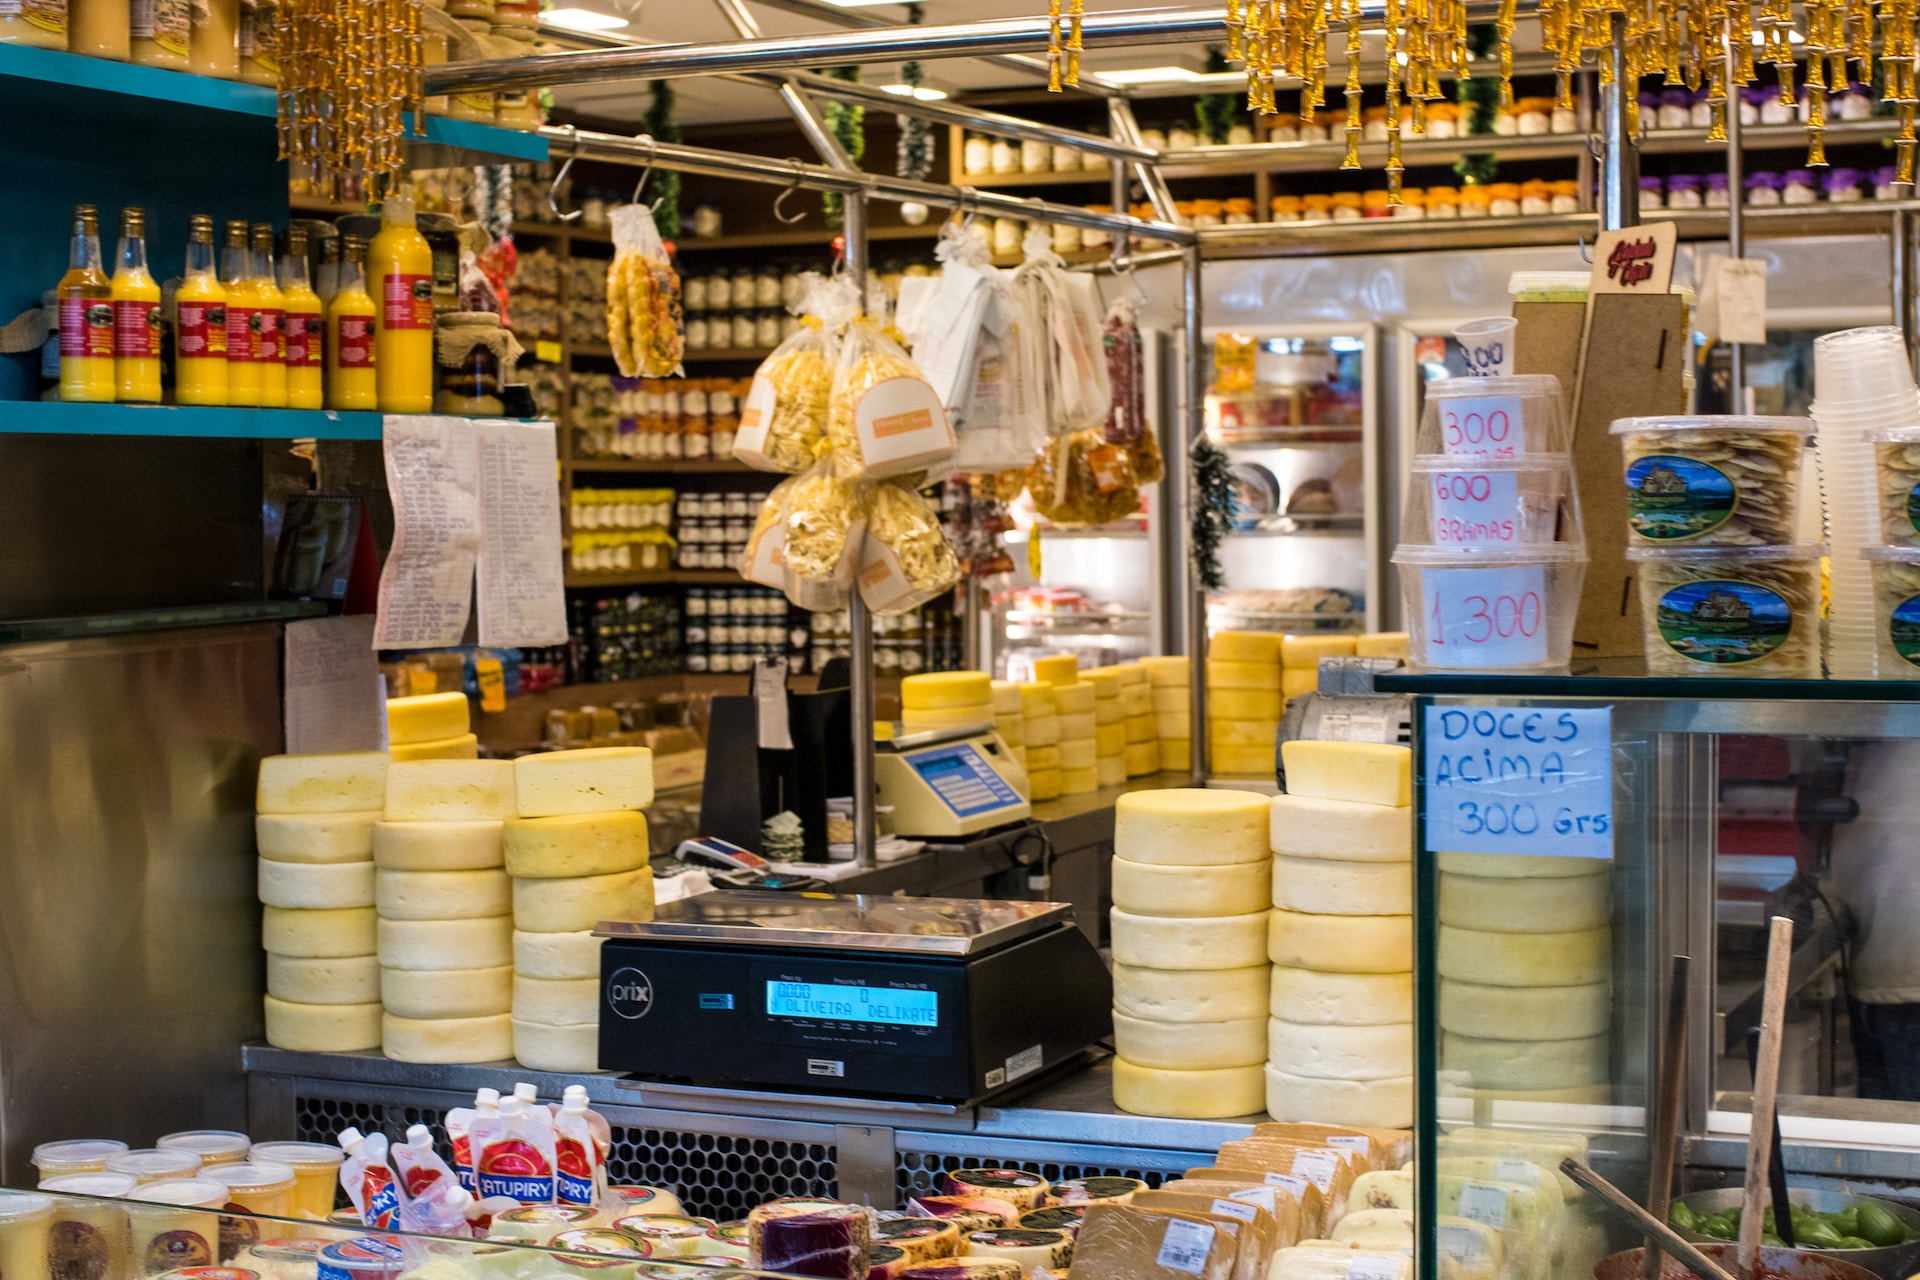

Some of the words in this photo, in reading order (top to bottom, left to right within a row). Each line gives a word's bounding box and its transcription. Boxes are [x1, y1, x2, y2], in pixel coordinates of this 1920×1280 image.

[1445, 410, 1510, 446] 300
[1436, 473, 1491, 502] 600
[1437, 517, 1514, 542] GRAMAS
[1441, 710, 1578, 743] DOCES
[1458, 801, 1539, 835] 300
[612, 981, 649, 1005] prix
[785, 998, 853, 1016] OLIVEIRA
[868, 1004, 937, 1022] DELIKATE
